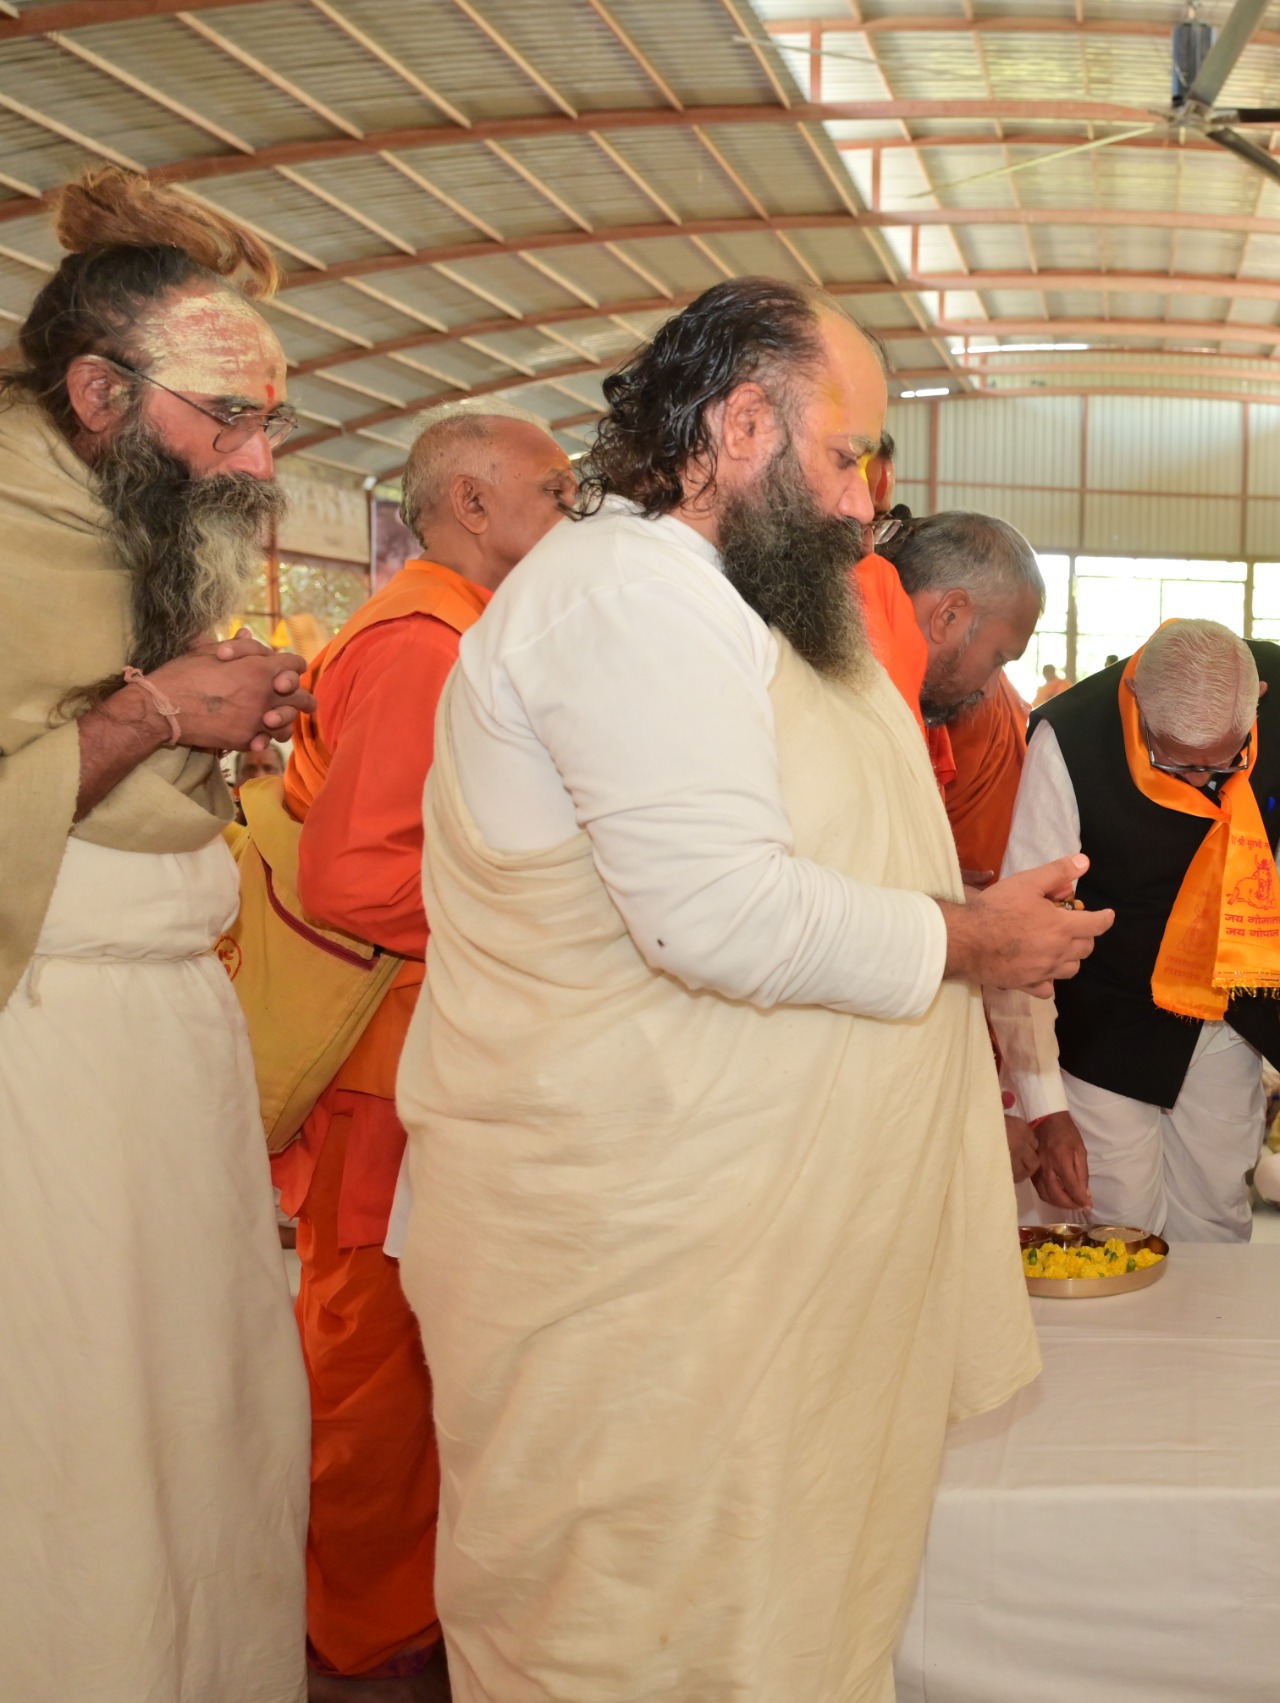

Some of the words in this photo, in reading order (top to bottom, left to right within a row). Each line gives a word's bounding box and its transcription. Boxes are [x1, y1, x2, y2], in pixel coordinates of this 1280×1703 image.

[1224, 913, 1243, 923] जय
[1247, 914, 1280, 924] गोमाता
[1225, 927, 1245, 936] जय
[1249, 928, 1279, 938] गोपाल
